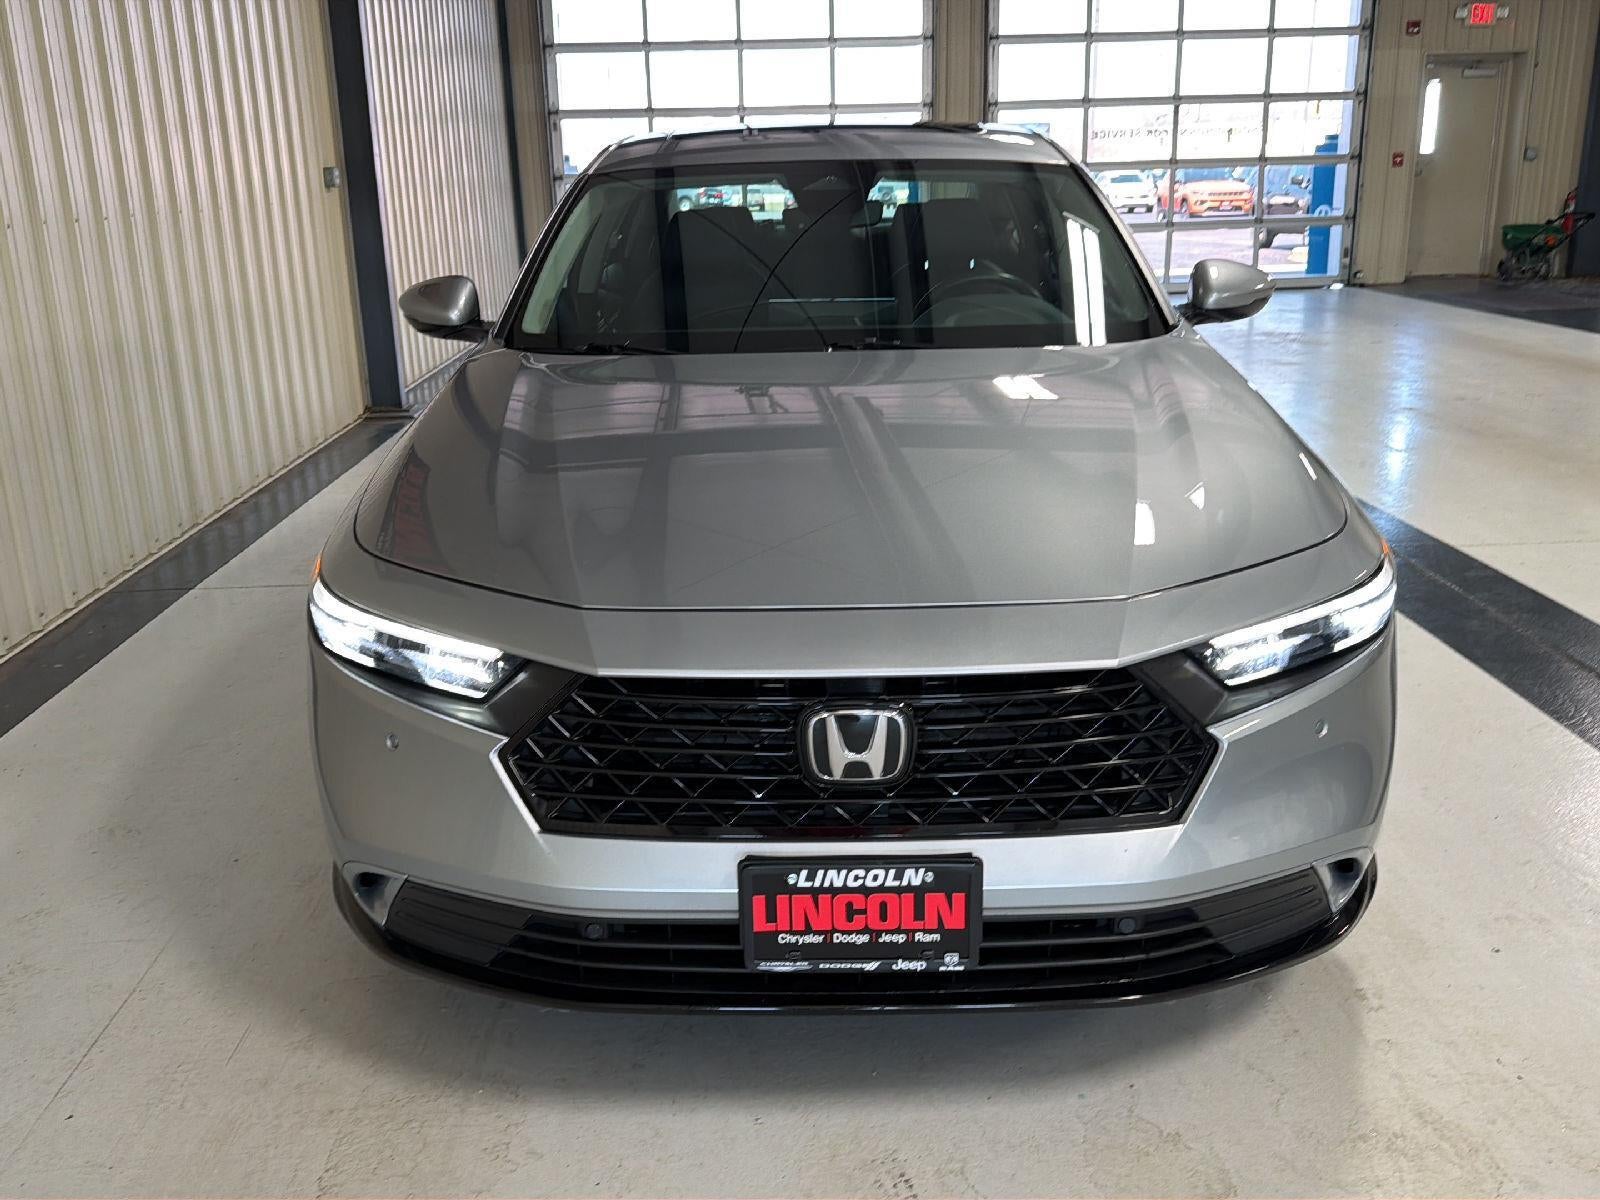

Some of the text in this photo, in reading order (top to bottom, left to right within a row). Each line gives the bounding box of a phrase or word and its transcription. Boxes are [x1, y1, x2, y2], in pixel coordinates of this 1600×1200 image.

[797, 868, 925, 888] LINCOLN
[752, 893, 966, 932] LINCOLN
[777, 932, 940, 945] Chrysler Dodge Jeep Ram
[892, 959, 927, 972] Jeep
